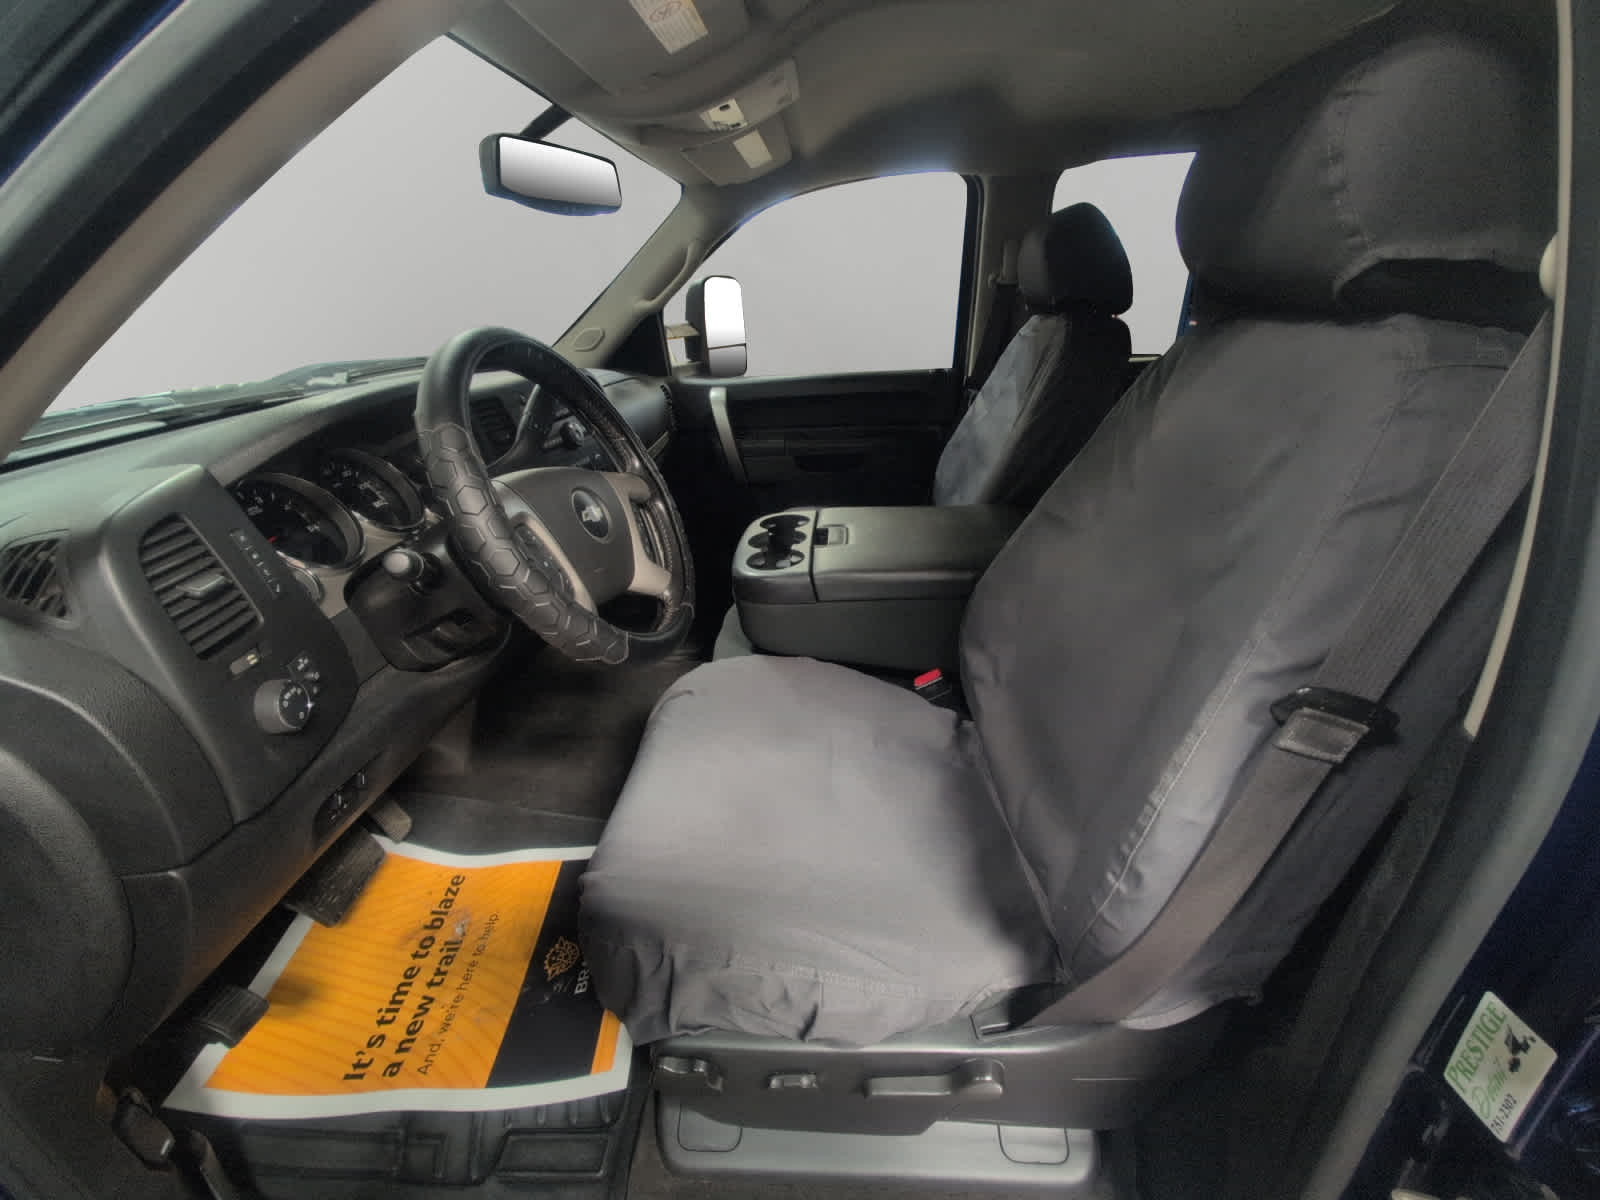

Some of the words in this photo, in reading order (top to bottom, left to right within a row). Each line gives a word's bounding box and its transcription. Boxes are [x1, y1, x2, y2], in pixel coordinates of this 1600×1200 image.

[423, 874, 465, 931] blaze
[411, 935, 436, 961] to
[376, 966, 421, 1028] time
[417, 1038, 446, 1076] And,
[456, 959, 479, 992] here
[472, 943, 487, 957] to
[343, 1034, 386, 1080] It's
[382, 1060, 404, 1077] a
[395, 995, 435, 1055] new
[1447, 1002, 1508, 1094] PRESTIGE
